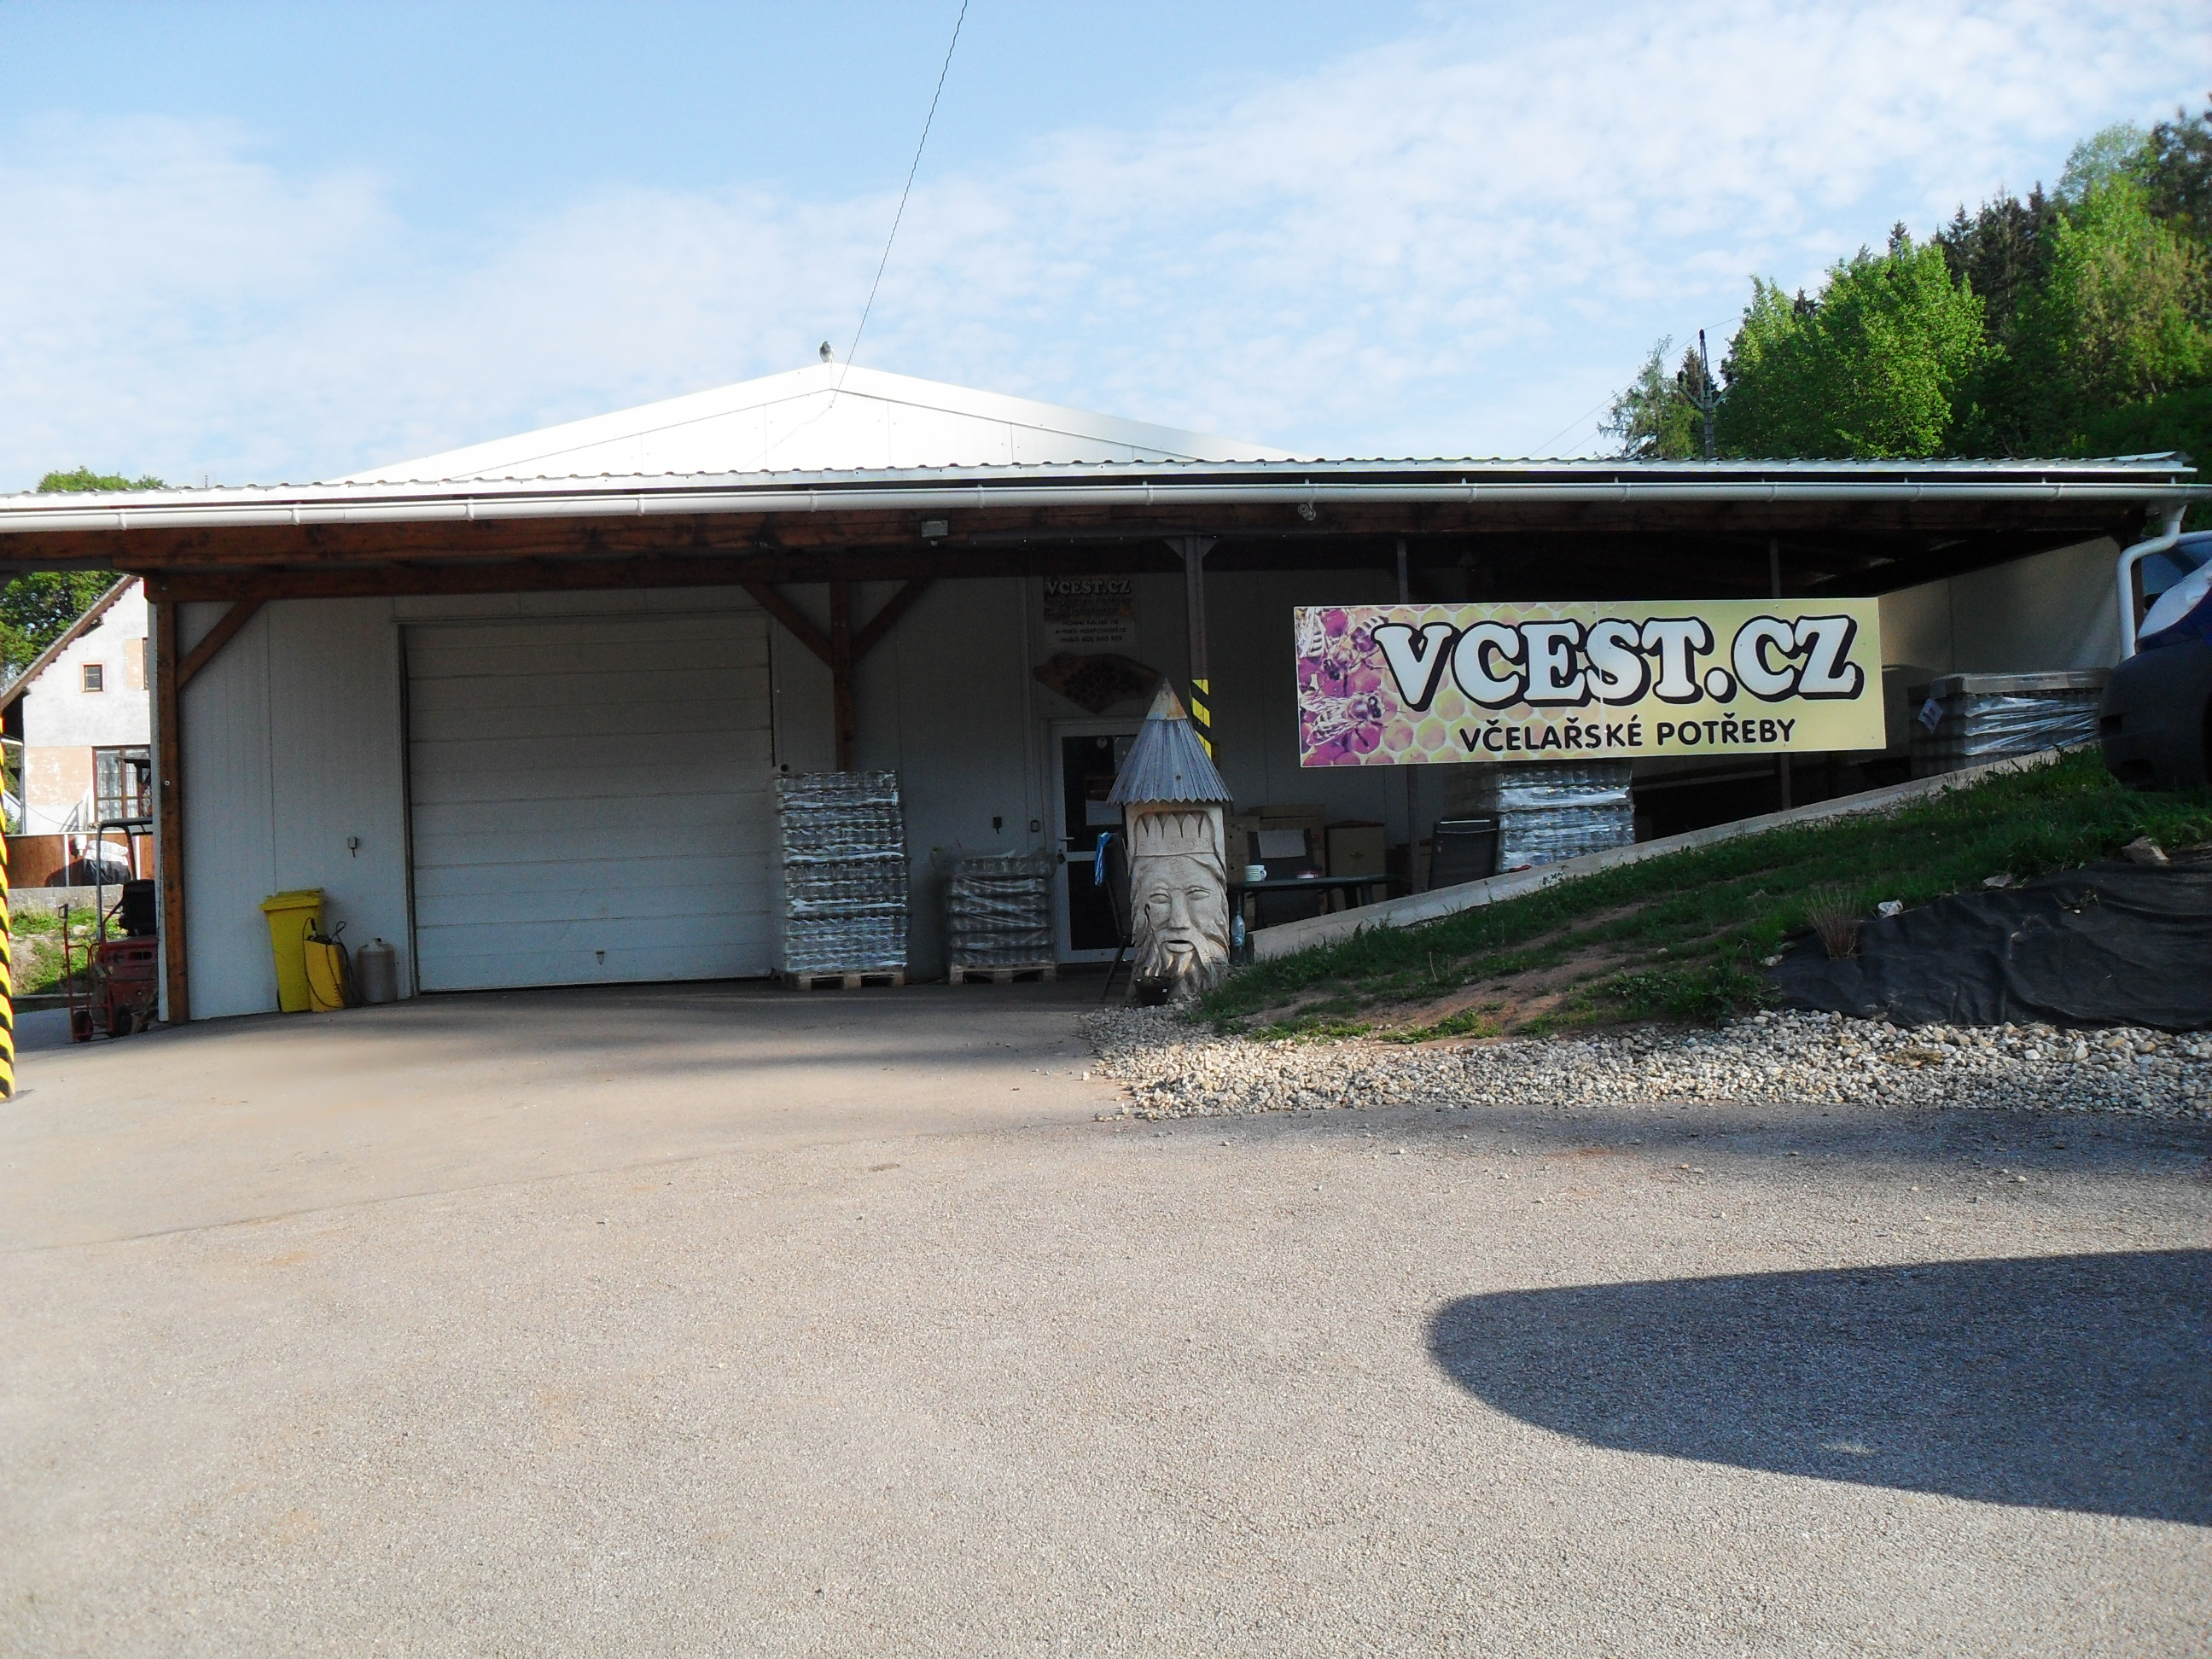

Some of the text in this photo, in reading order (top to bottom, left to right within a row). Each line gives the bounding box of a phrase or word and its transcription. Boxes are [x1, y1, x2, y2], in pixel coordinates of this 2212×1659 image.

[1045, 579, 1131, 595] VCEST.CZ
[1372, 614, 1865, 713] VCEST.CZ
[1458, 712, 1796, 753] VČELAŘSKÉ POTŘEBY
